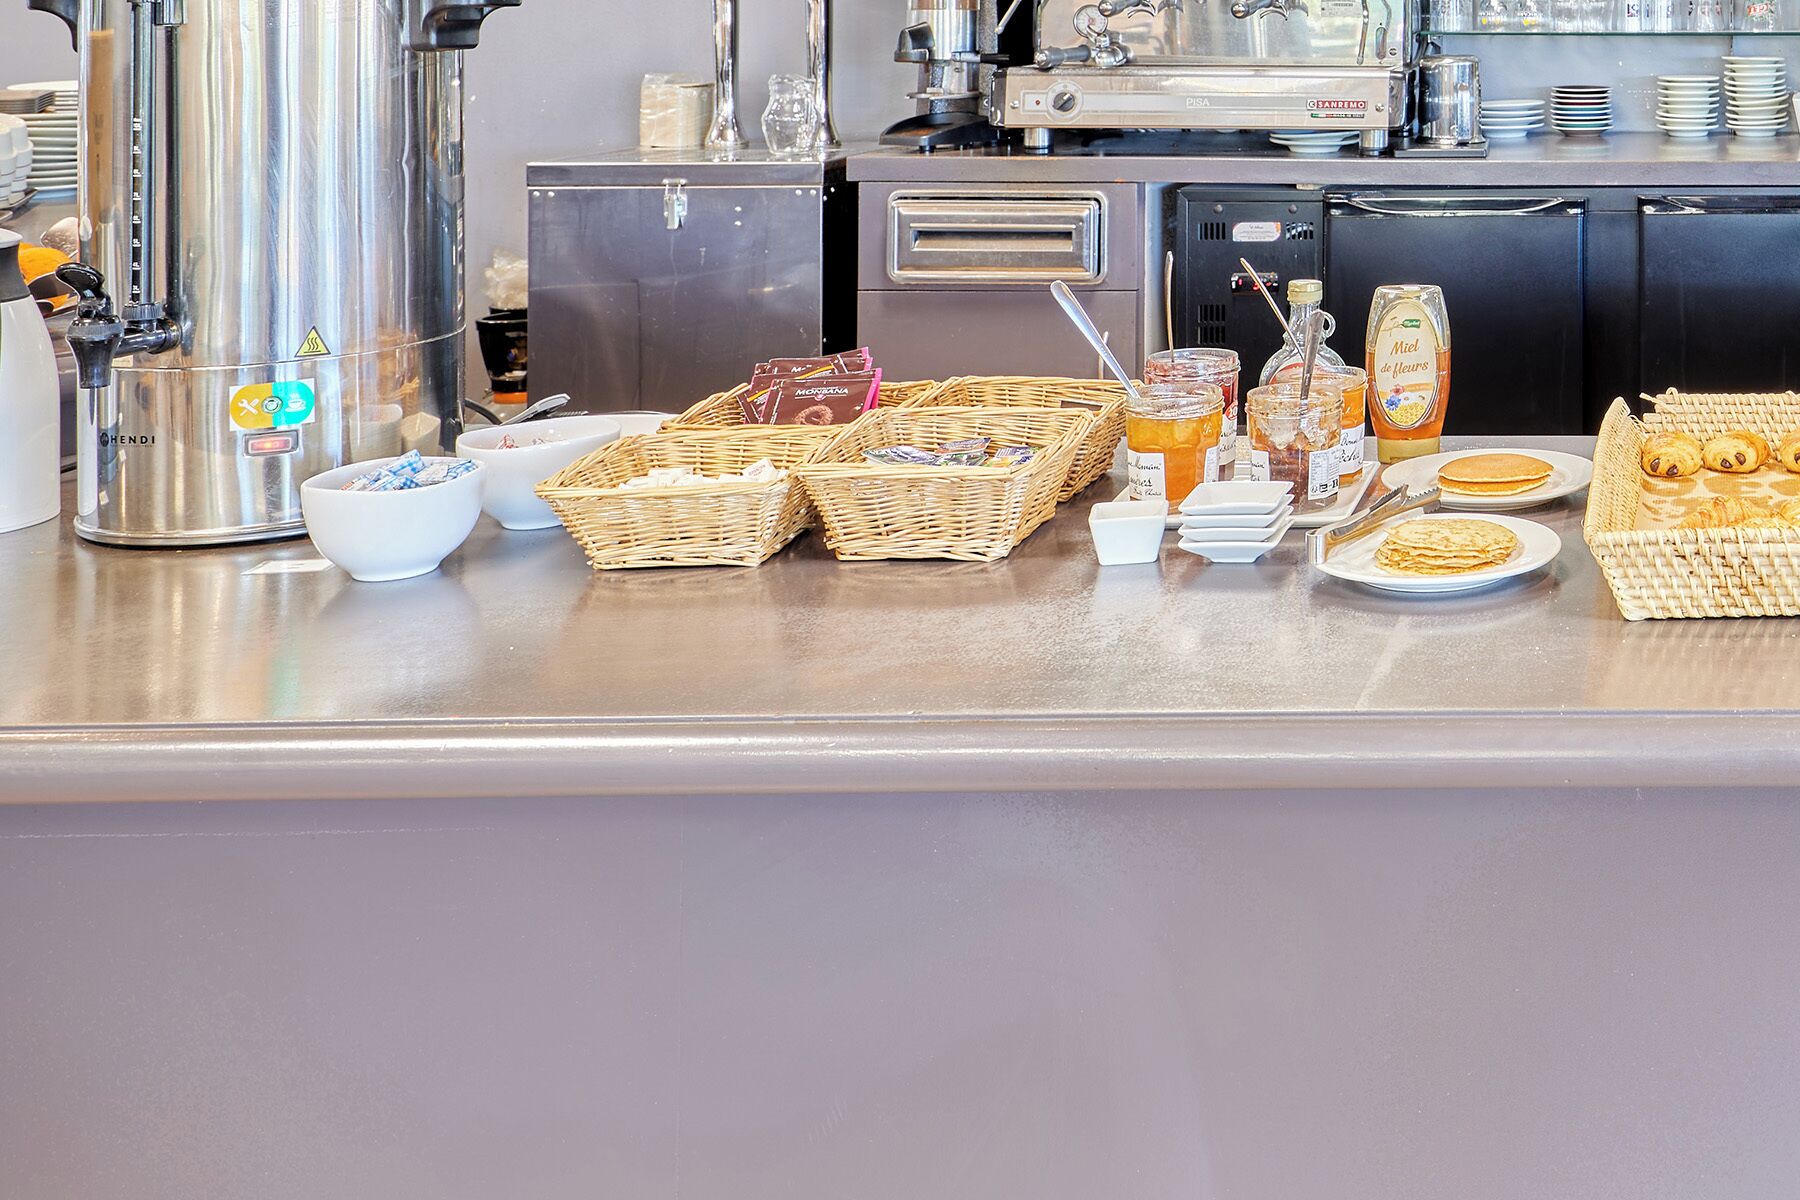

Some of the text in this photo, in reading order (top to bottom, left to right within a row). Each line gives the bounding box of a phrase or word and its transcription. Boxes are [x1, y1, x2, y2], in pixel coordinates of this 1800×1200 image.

[1186, 98, 1365, 109] PISA SANREMO
[1390, 339, 1419, 355] Miel
[1380, 360, 1429, 379] de fleurs
[111, 434, 155, 445] HENDI
